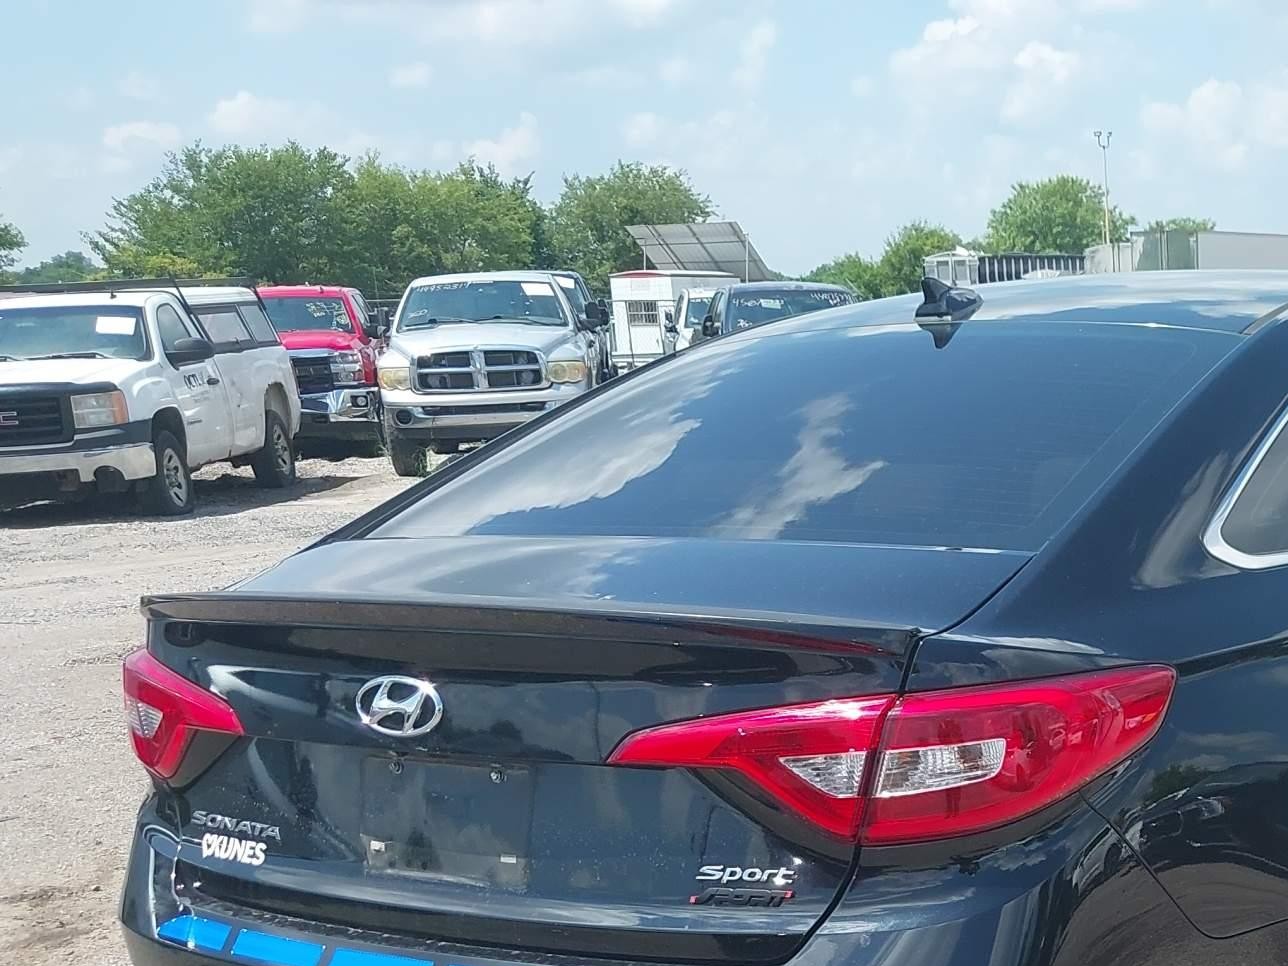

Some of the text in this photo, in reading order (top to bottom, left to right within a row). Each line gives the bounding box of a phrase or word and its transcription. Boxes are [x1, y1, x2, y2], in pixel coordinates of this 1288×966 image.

[191, 810, 281, 840] SONATA
[212, 834, 268, 866] KUNES
[695, 865, 796, 885] Sport
